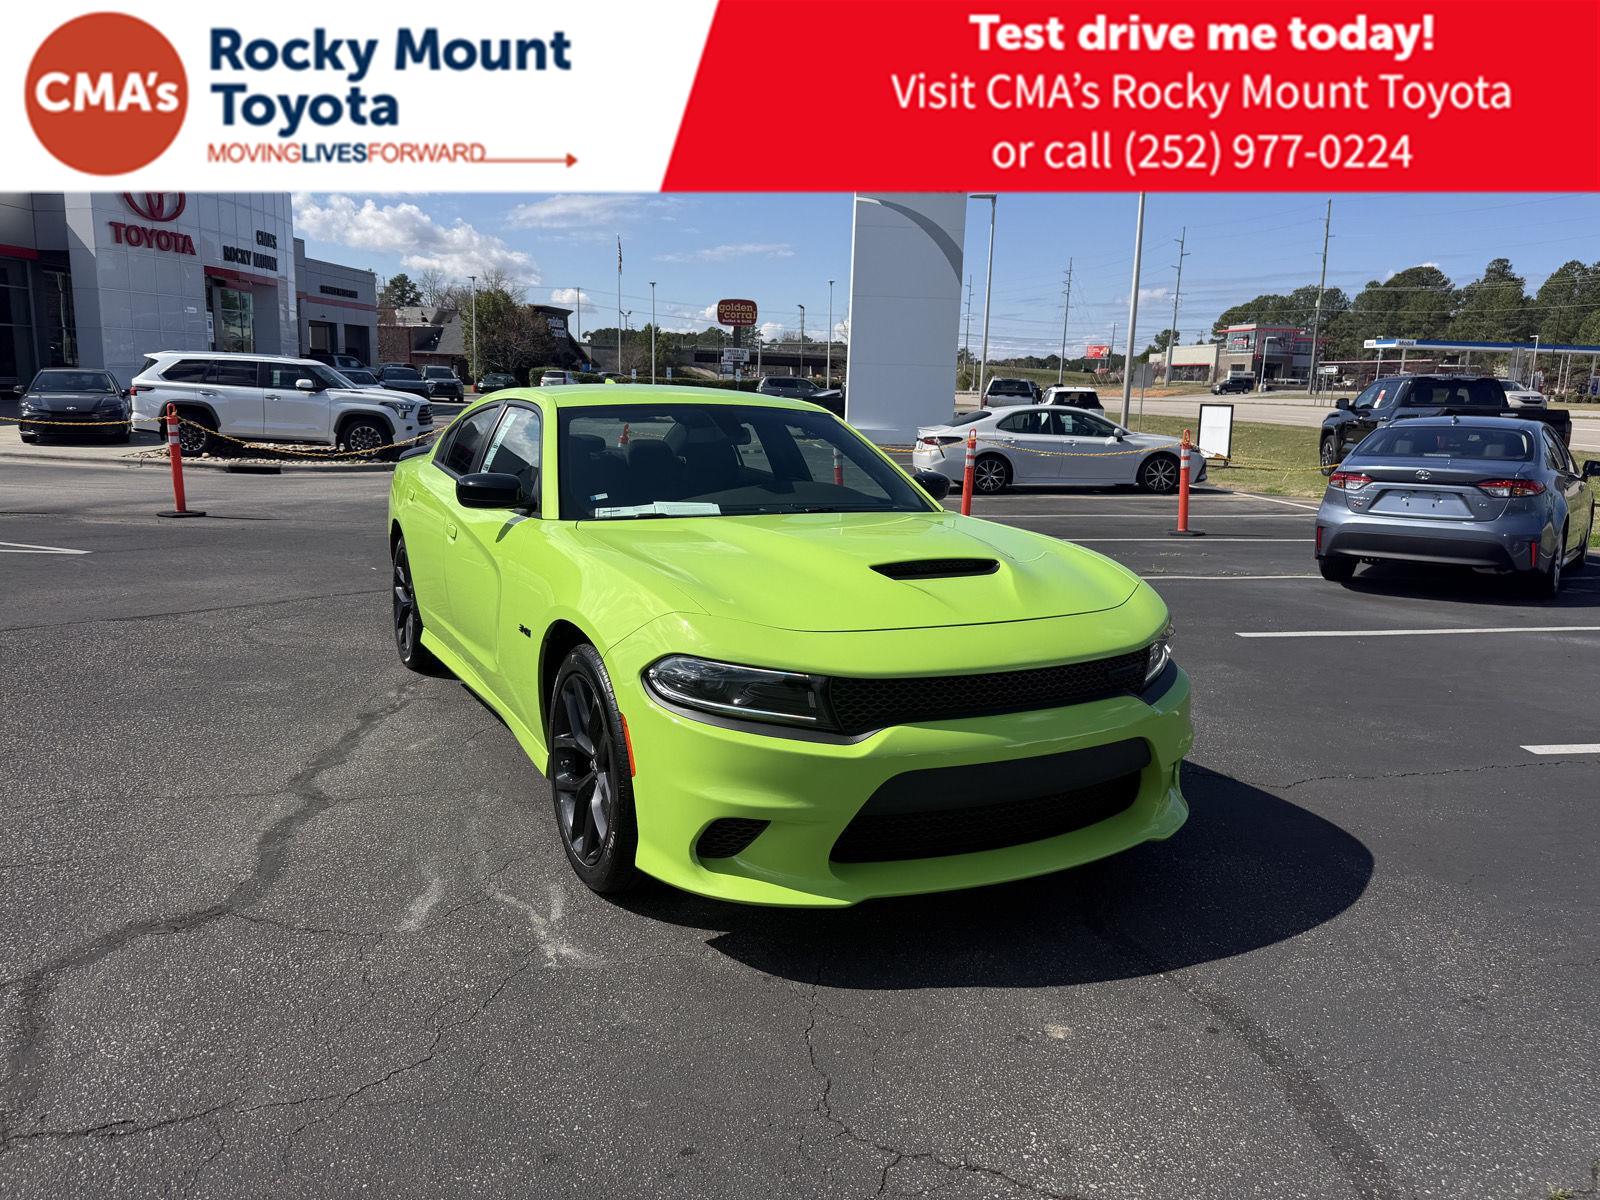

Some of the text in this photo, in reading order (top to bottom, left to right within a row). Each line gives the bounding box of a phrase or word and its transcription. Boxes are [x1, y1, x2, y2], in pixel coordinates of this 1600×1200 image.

[109, 221, 197, 256] TOYOTA
[223, 245, 251, 266] ROCKY
[719, 303, 753, 314] golden
[724, 311, 756, 320] corral
